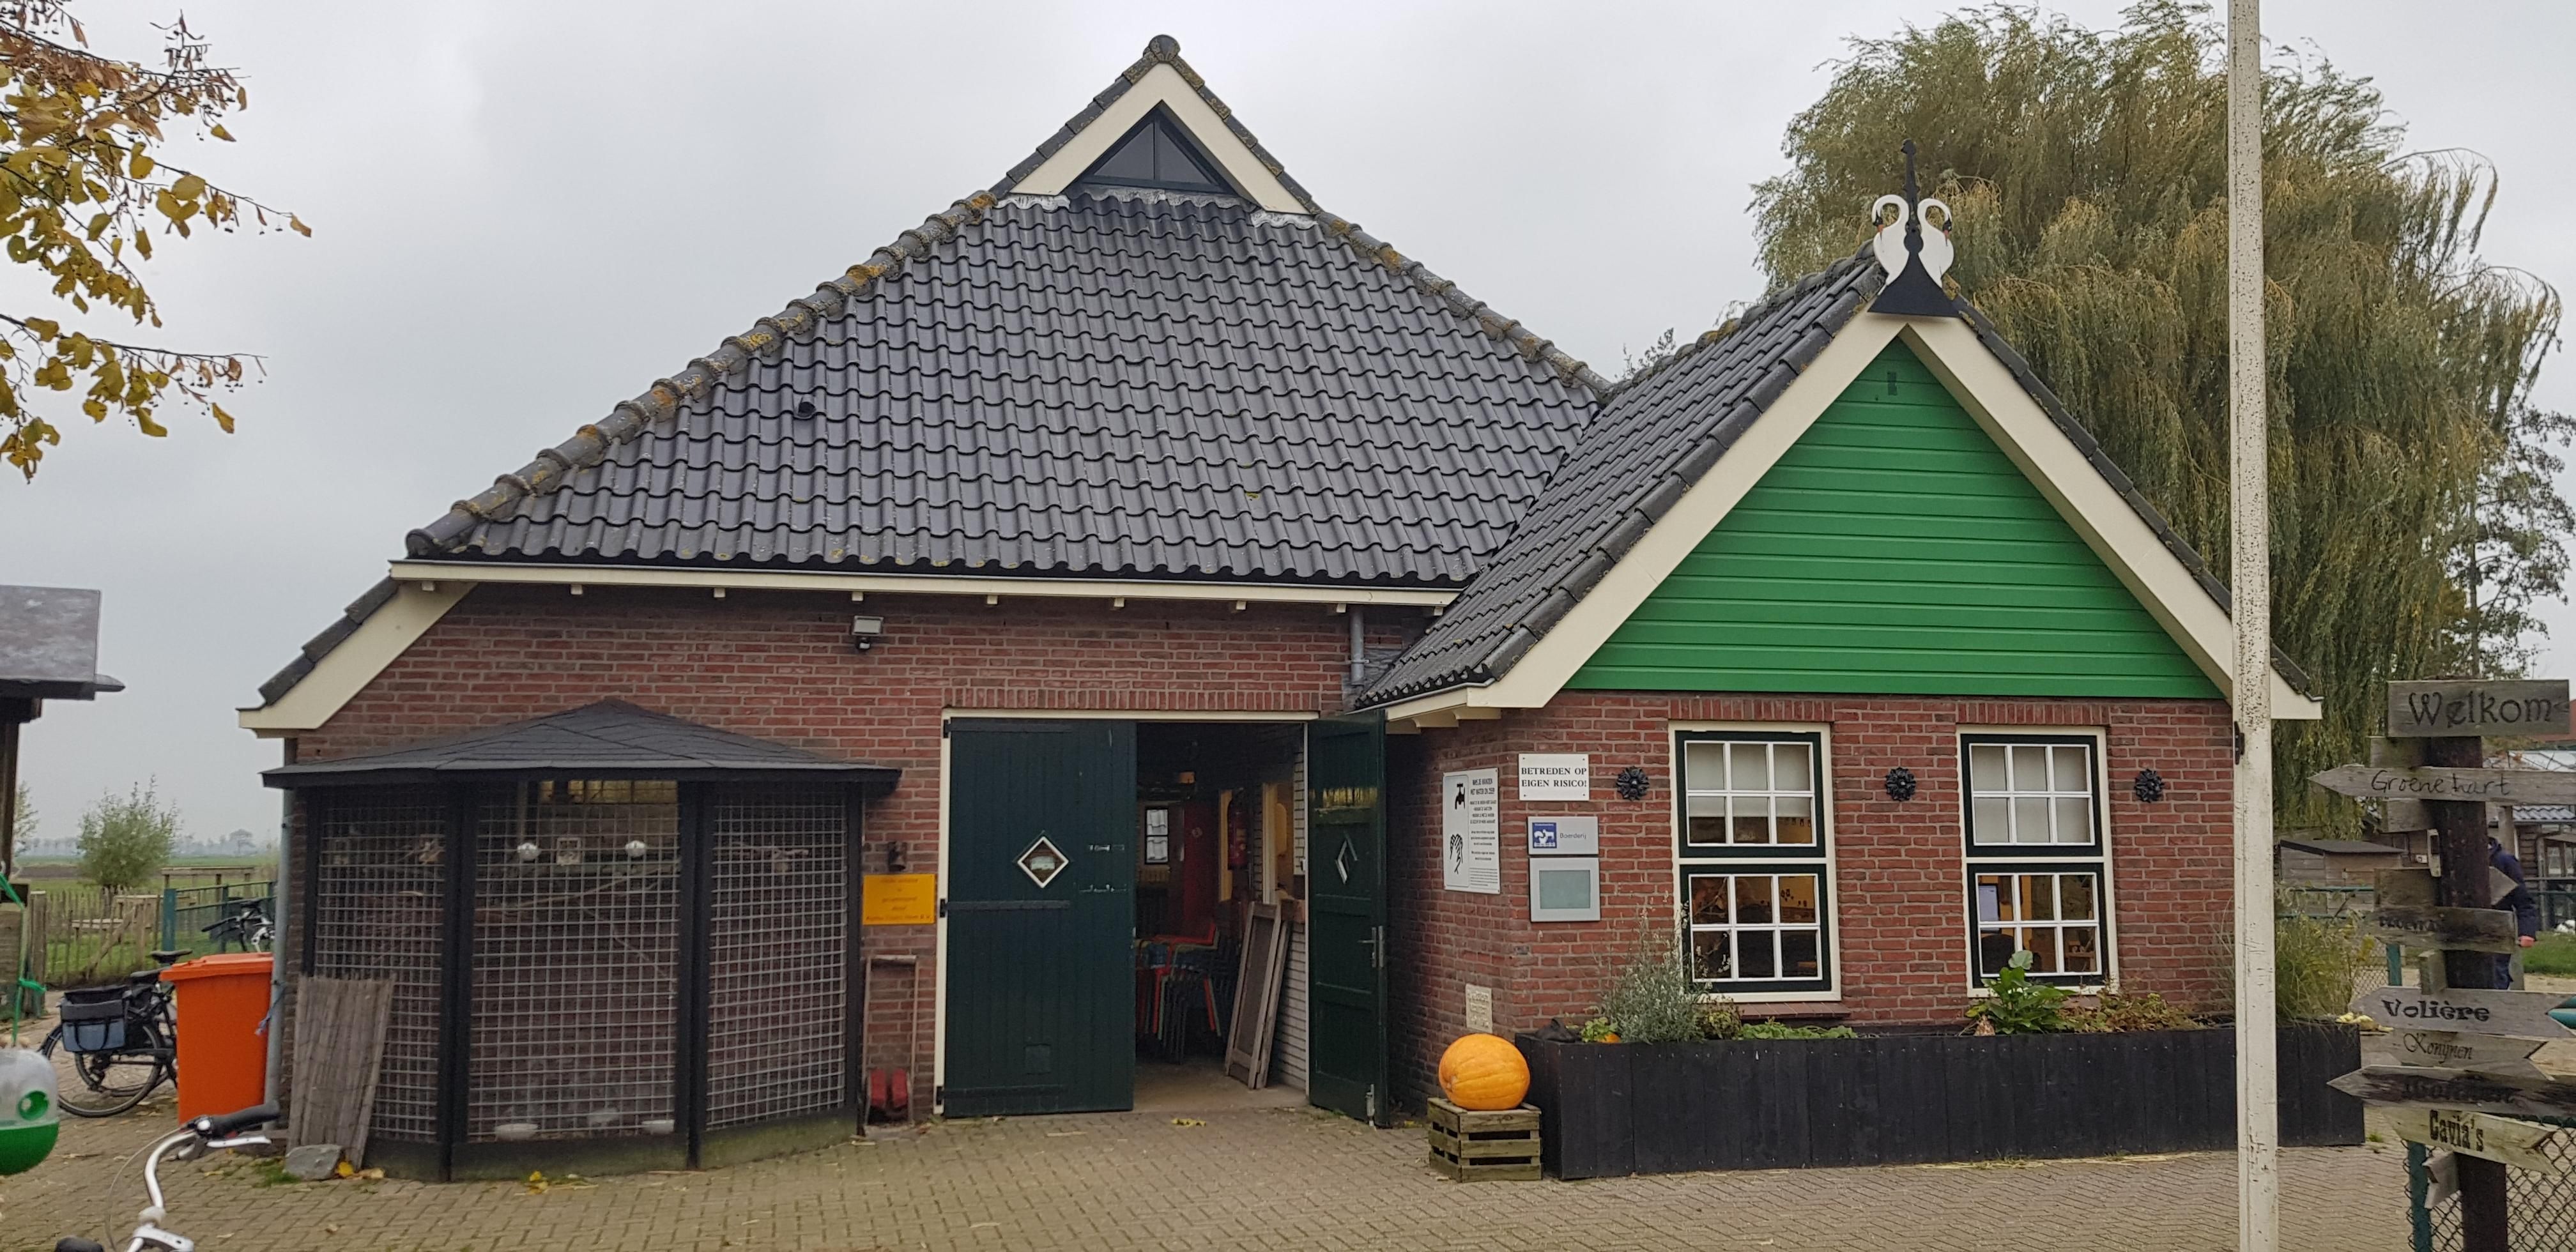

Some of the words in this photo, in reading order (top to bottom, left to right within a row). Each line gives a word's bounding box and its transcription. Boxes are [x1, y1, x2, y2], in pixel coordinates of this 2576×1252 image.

[2408, 691, 2552, 728] Welkom
[1521, 767, 1571, 775] BETREDEN
[1574, 767, 1587, 775] OP
[2371, 770, 2444, 793] Groene
[1521, 779, 1550, 788] EIGEN
[1553, 779, 1588, 788] RISICO!
[2381, 998, 2490, 1022] Volière
[2429, 1108, 2484, 1152] Cavia's
